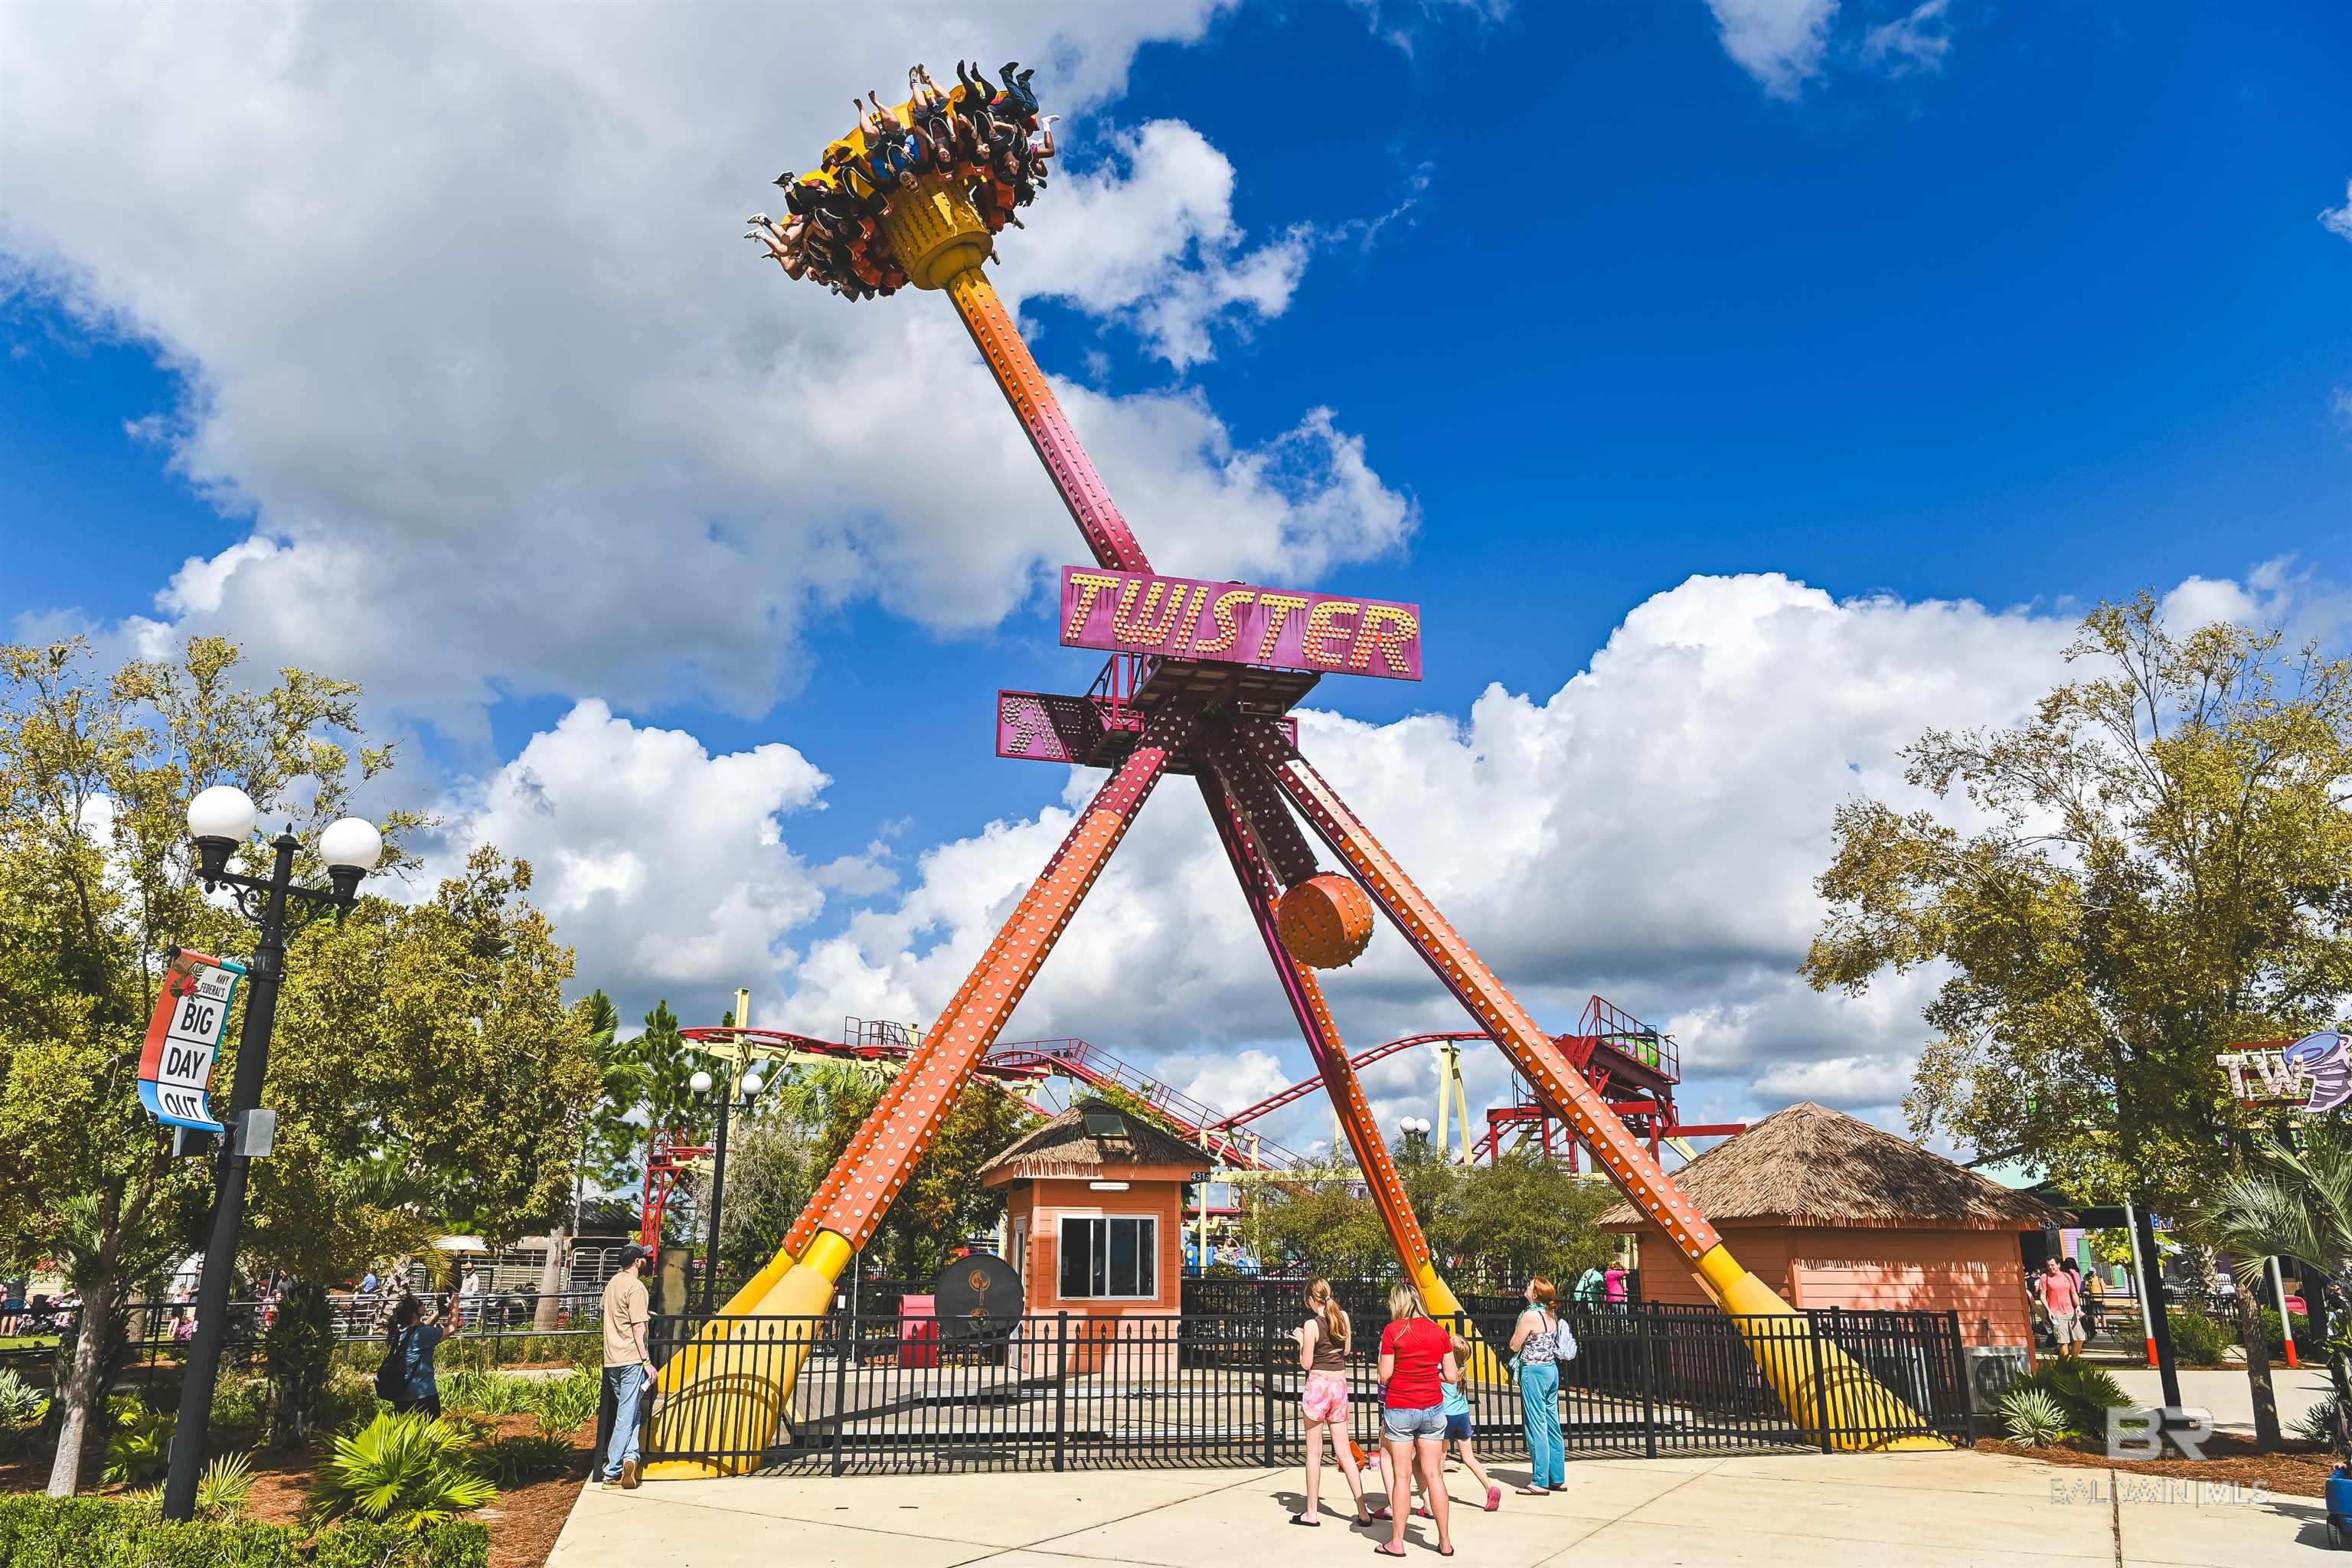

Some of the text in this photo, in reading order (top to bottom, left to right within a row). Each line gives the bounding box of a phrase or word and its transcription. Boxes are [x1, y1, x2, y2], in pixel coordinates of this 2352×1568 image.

[1063, 572, 1419, 672] TWISTER
[200, 982, 226, 998] FEDERAL'S
[215, 973, 231, 986] NAVY
[180, 1002, 214, 1035] BIG
[166, 1047, 206, 1080] DAY
[165, 1093, 201, 1119] OUT
[1191, 1172, 1210, 1181] 431a
